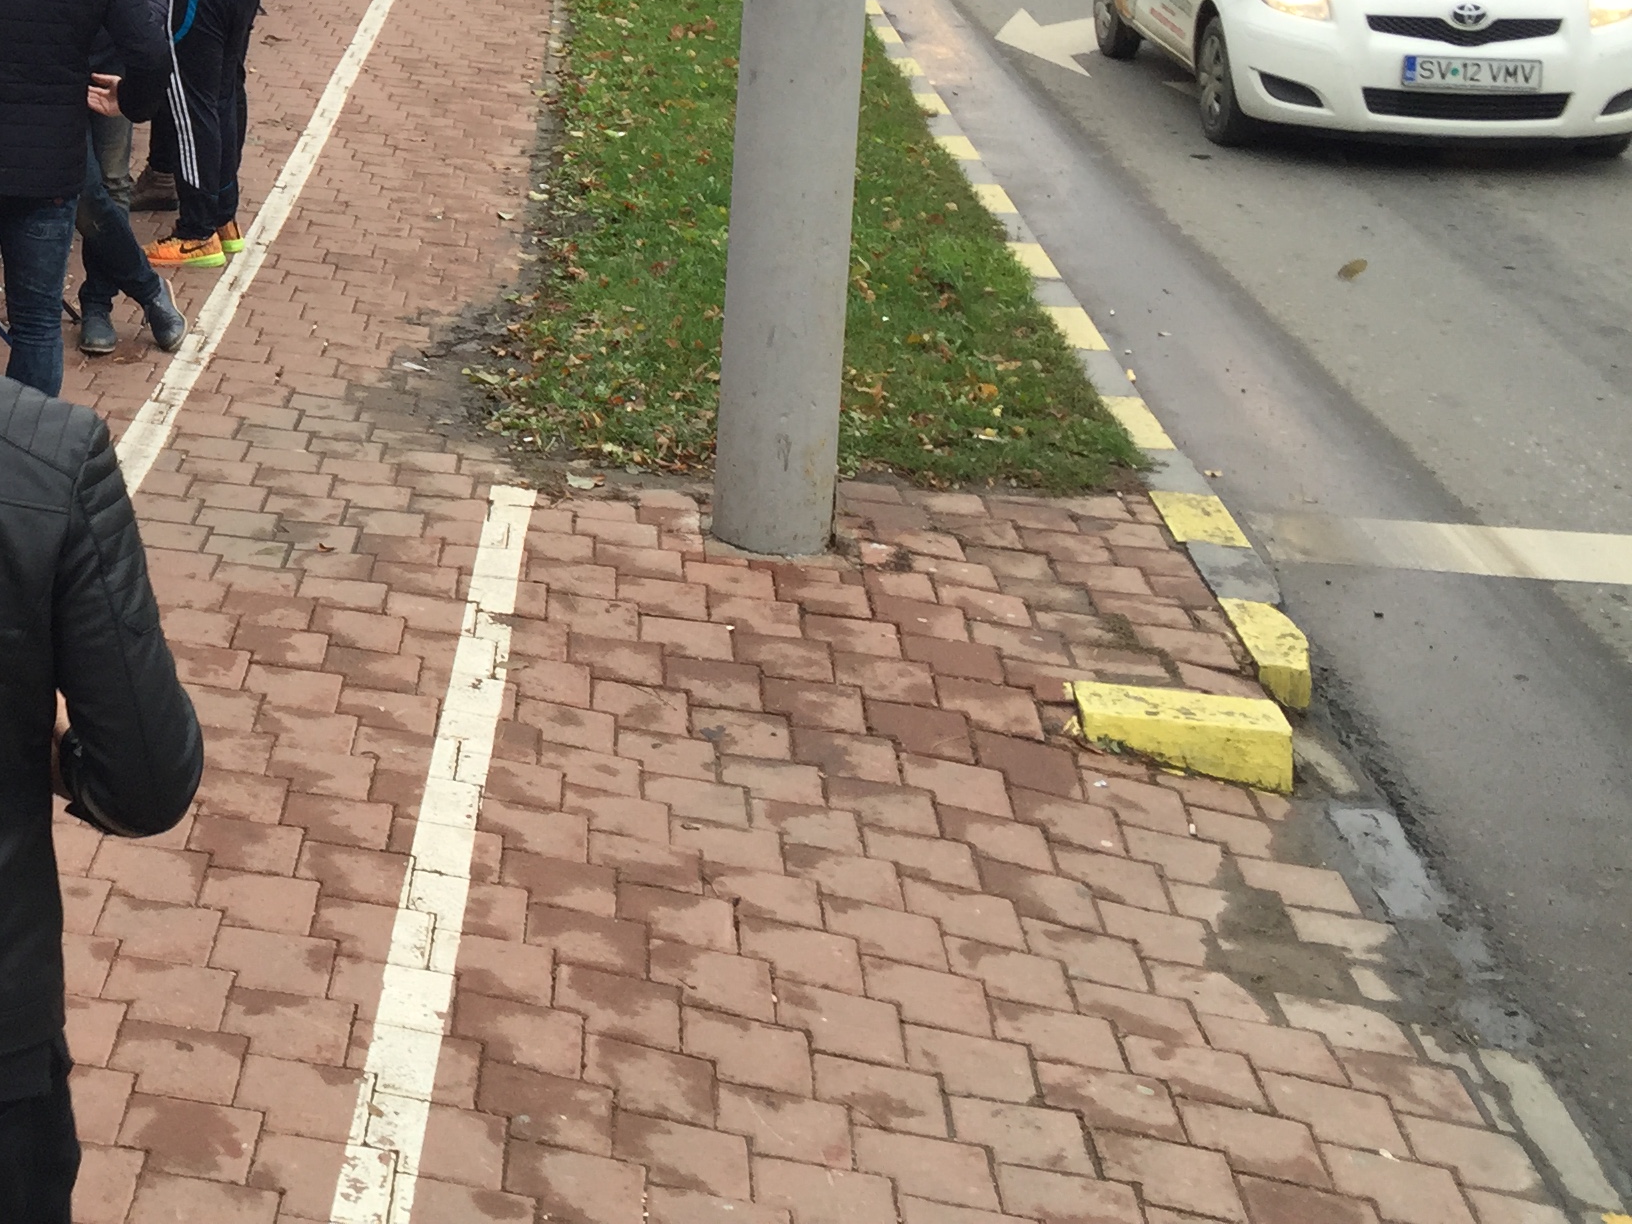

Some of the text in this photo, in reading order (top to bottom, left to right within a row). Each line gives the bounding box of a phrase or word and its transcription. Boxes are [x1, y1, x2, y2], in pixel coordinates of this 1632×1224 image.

[1419, 60, 1535, 84] SV 12 VMV
